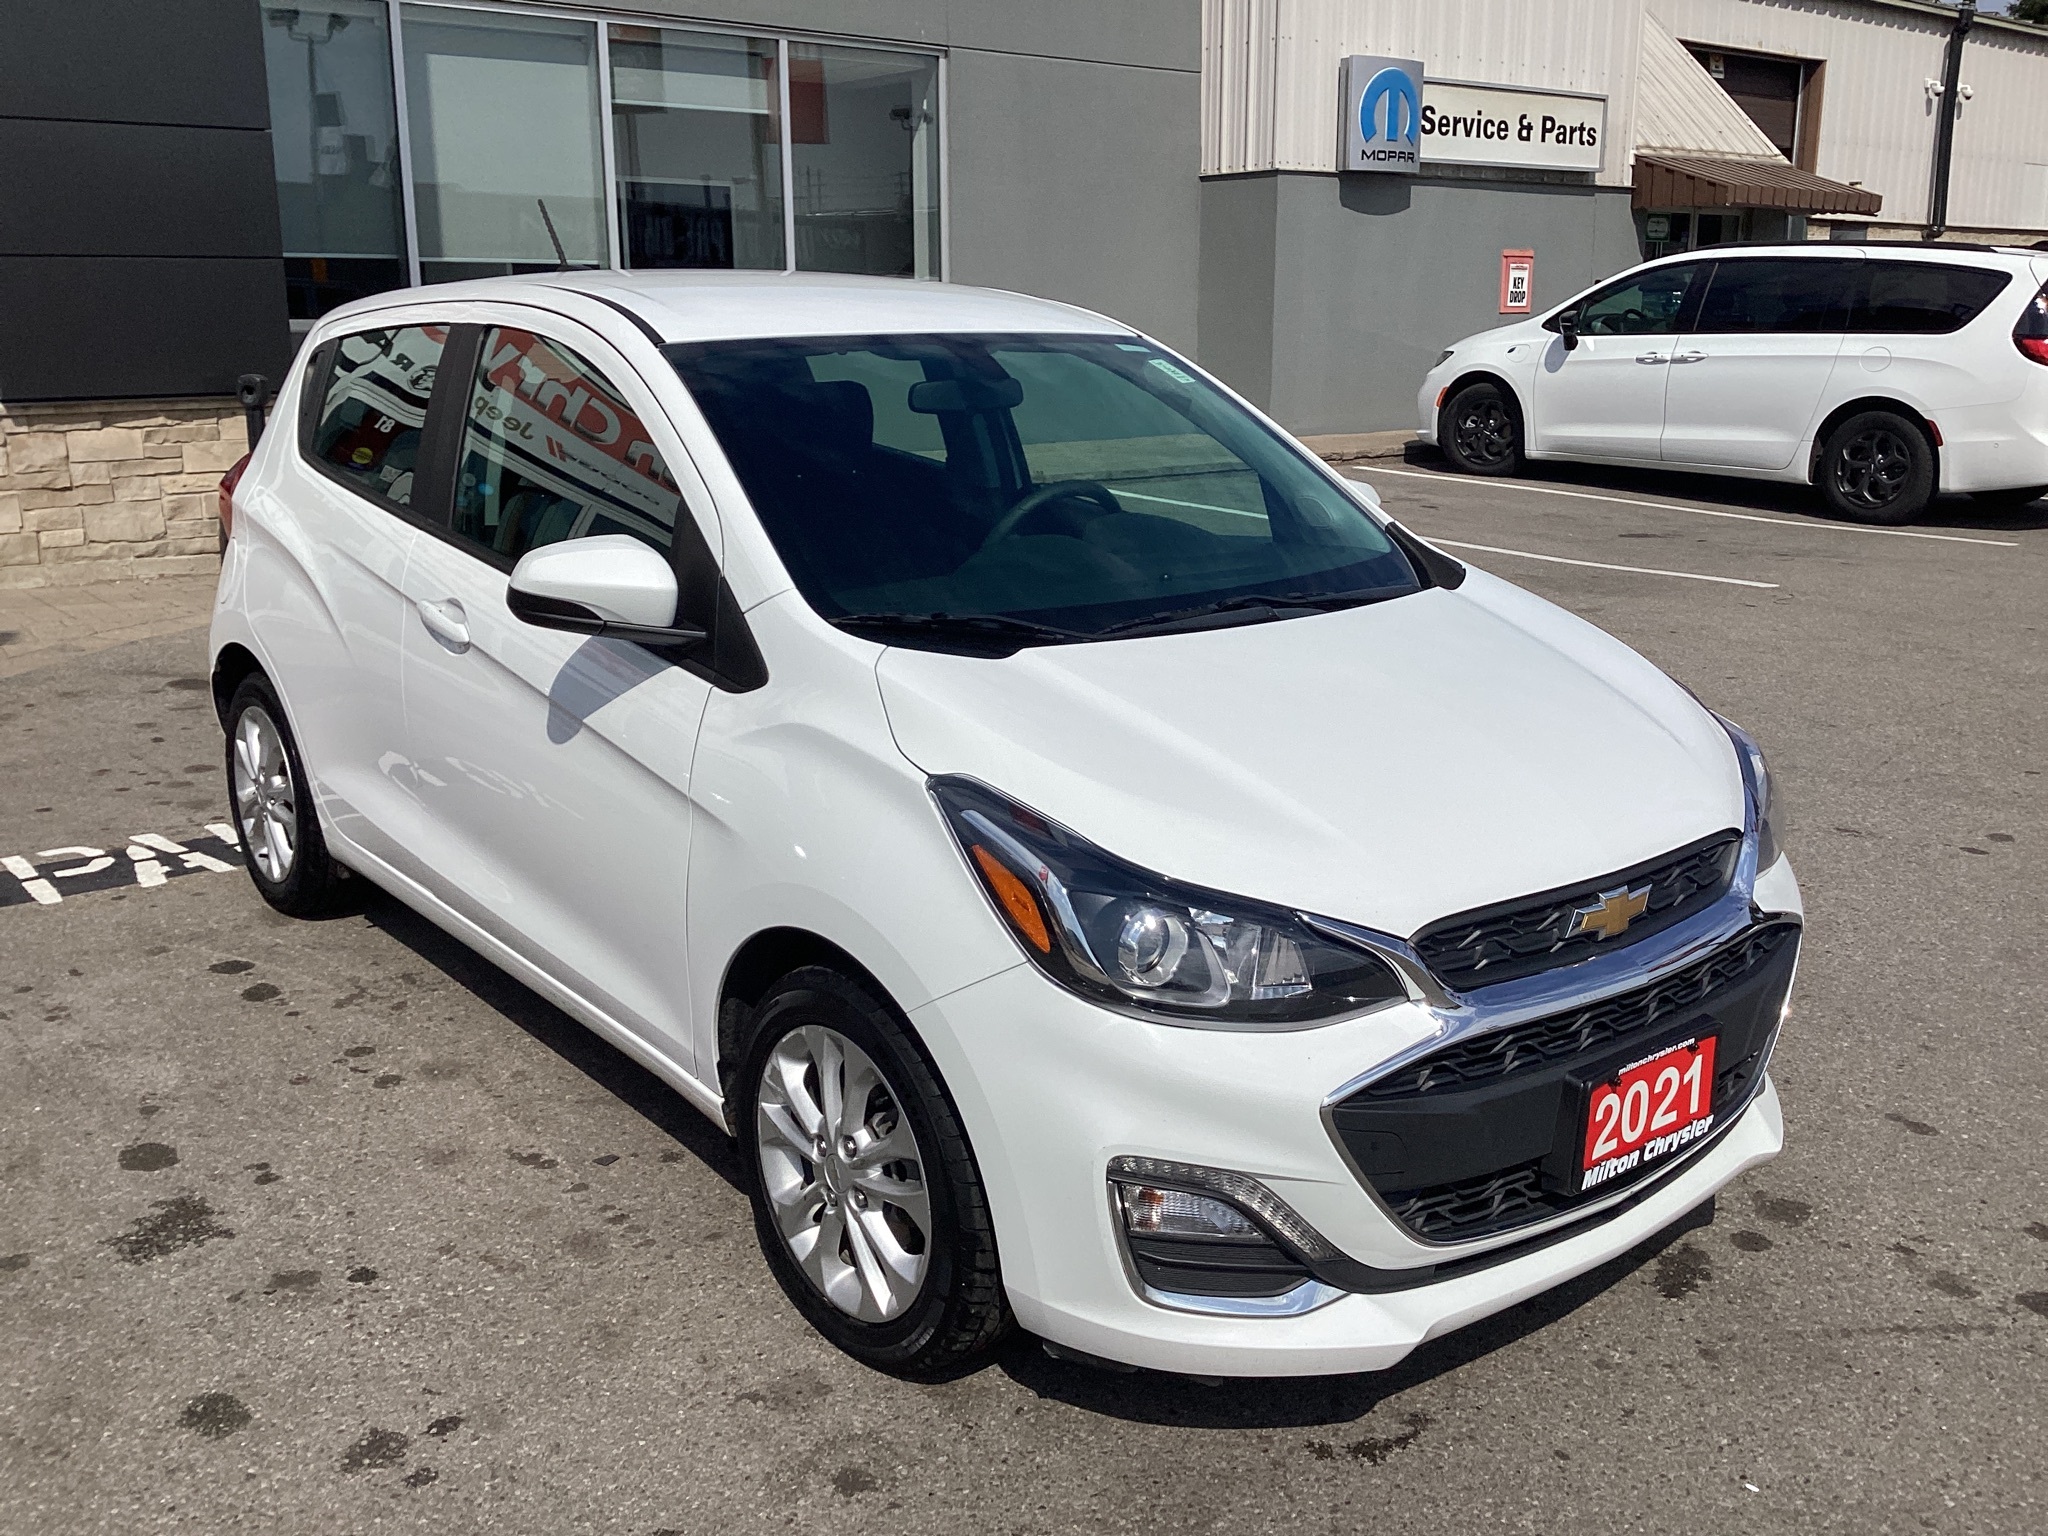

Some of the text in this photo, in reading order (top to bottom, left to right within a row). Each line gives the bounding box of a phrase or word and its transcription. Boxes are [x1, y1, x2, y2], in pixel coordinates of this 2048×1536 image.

[1421, 105, 1598, 147] Service & Parts
[1361, 149, 1415, 164] MOPAR
[1509, 290, 1526, 303] DROP
[1512, 276, 1525, 290] KEY
[1617, 1037, 1696, 1076] miltonchrysler.com
[1590, 1053, 1704, 1162] 2021
[1580, 1114, 1715, 1192] Milton Chrysler
